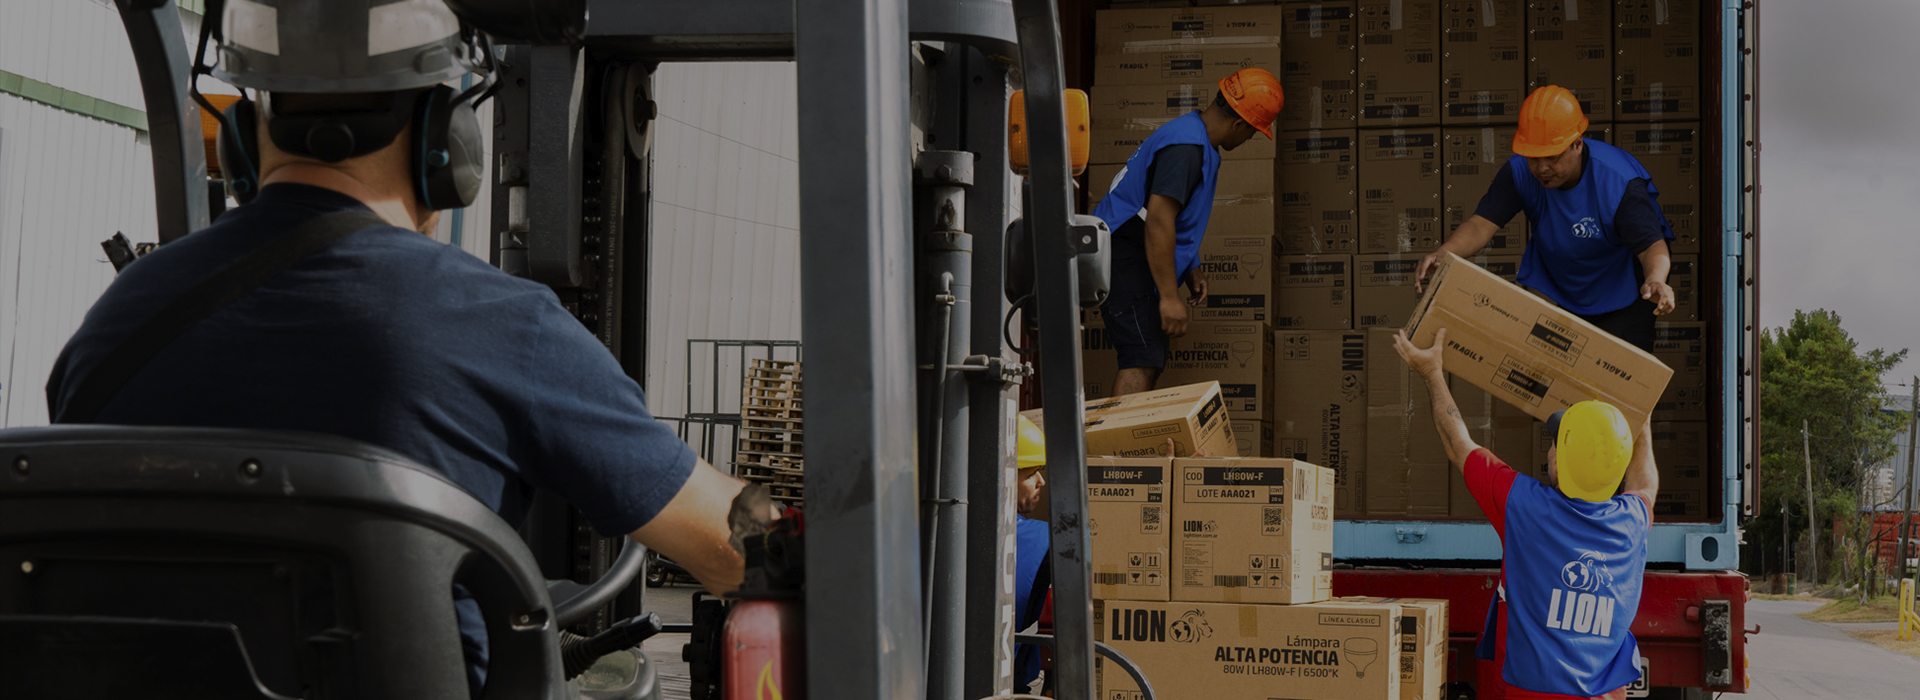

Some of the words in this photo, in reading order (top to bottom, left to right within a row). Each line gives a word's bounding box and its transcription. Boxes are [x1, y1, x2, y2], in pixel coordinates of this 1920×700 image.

[1366, 190, 1381, 199] LION
[1204, 254, 1239, 262] Lámpara
[1361, 316, 1376, 325] LION
[1194, 341, 1229, 350] Lámpara
[1448, 340, 1477, 361] FRAGIL
[1175, 351, 1228, 361] POTENCIA
[1342, 335, 1364, 371] LION
[1602, 360, 1631, 381] FRAGIL
[1330, 404, 1340, 428] ALTA
[1137, 428, 1153, 437] LÍNEA
[1154, 426, 1177, 434] CLASSIC
[1341, 450, 1349, 486] Lámpara
[1103, 471, 1143, 480] LH80W-F
[1186, 472, 1202, 480] COD
[1223, 472, 1264, 480] LH80W-F
[1101, 488, 1134, 496] AAA021
[1197, 489, 1218, 498] LOTE
[1221, 490, 1255, 498] AAA021
[1184, 521, 1202, 532] LION
[1546, 588, 1615, 637] LION
[1112, 608, 1166, 642] LION
[1287, 635, 1340, 650] Lámpara
[1214, 646, 1256, 662] ALTA
[1259, 648, 1339, 666] POTENCIA
[1223, 665, 1245, 674] 80W
[1252, 666, 1296, 676] LH80W-F
[1304, 668, 1339, 678] 6500°K
